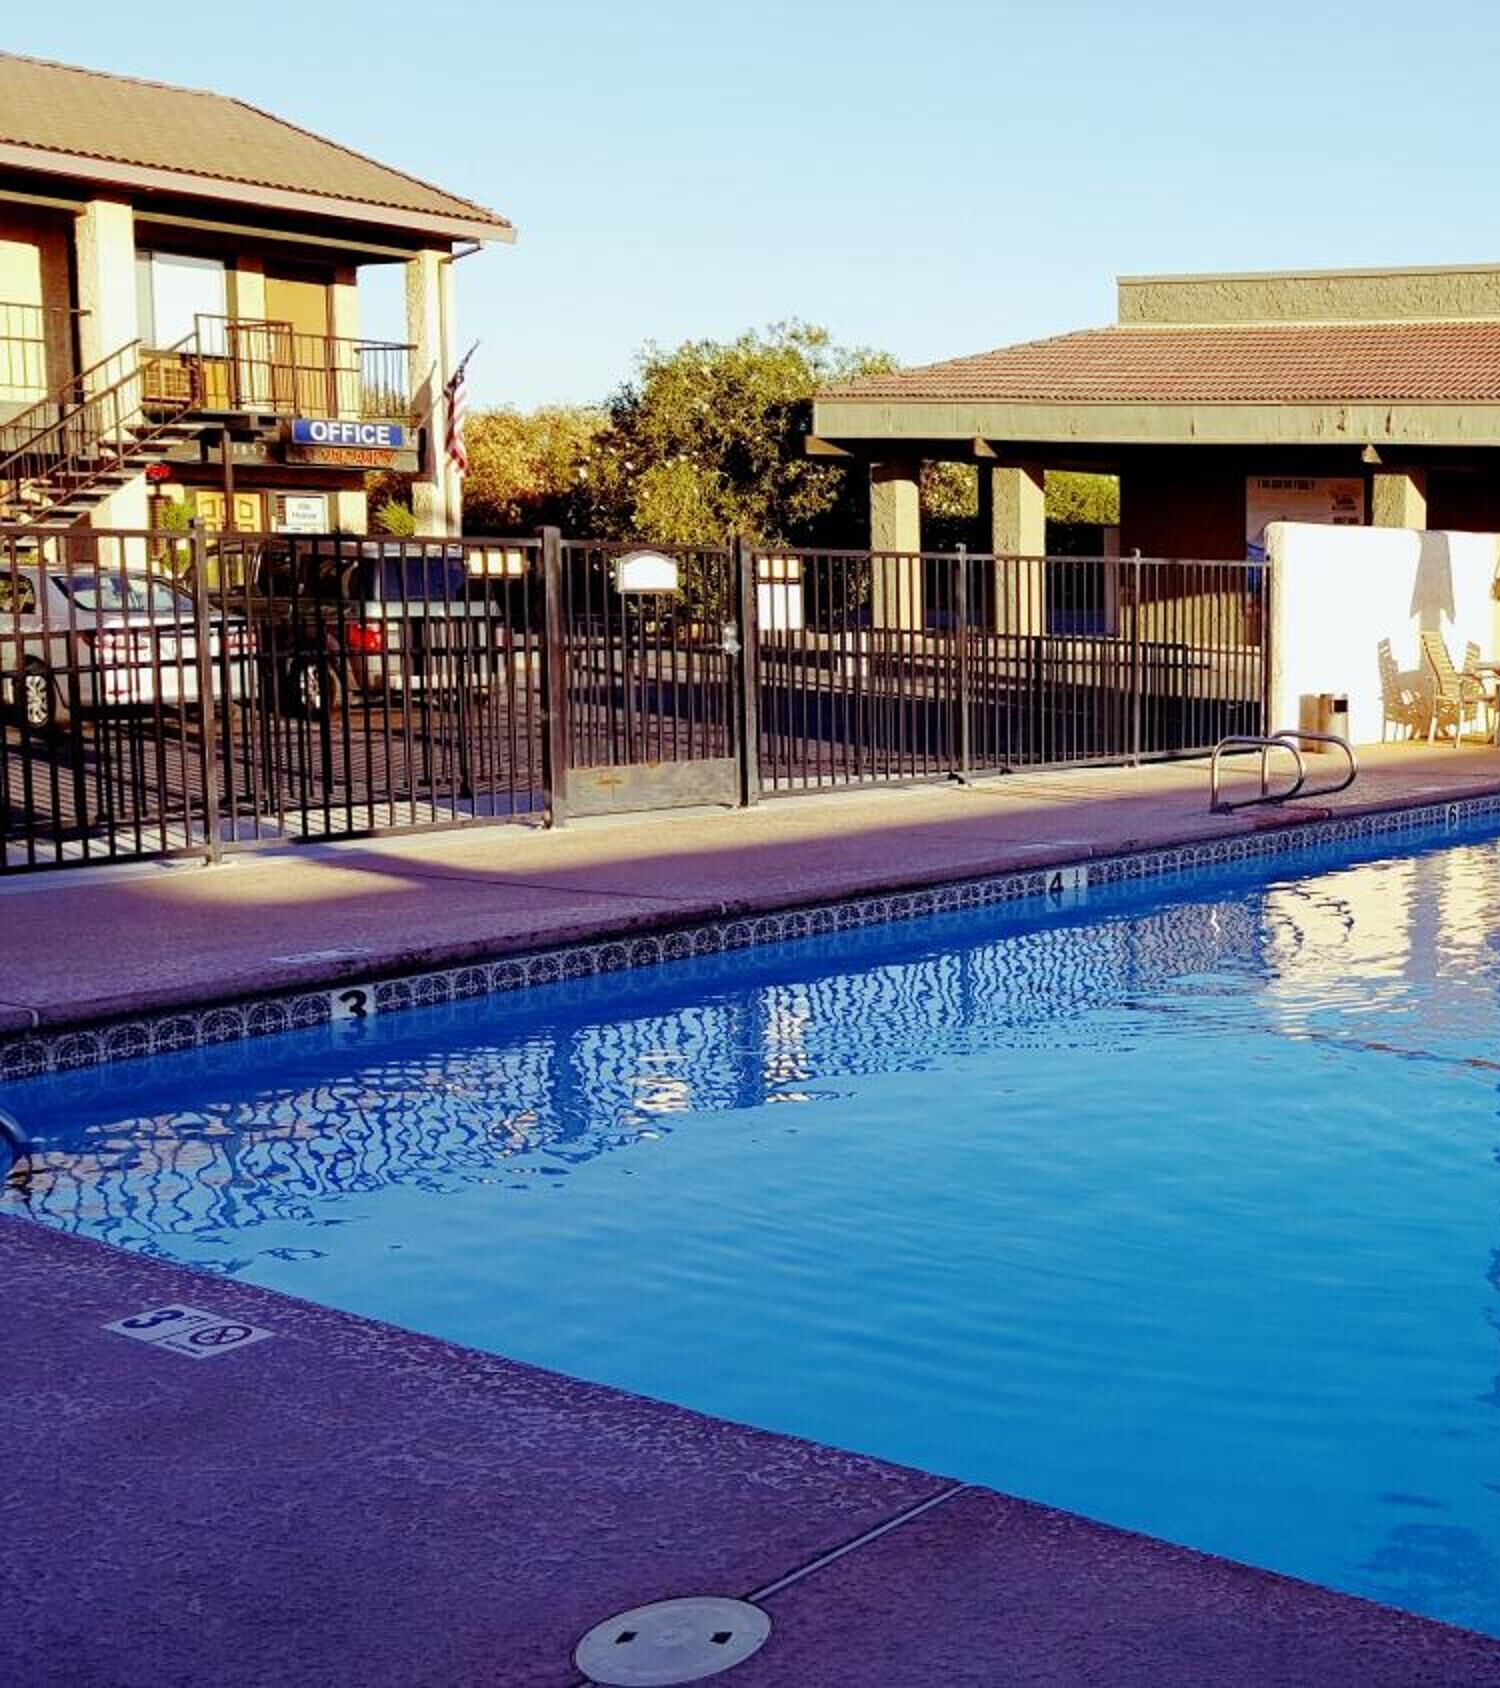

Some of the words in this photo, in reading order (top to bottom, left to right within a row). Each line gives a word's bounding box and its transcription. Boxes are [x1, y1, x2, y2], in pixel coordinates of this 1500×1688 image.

[310, 421, 391, 445] OFFICE
[1448, 804, 1457, 825] 6
[338, 990, 368, 1019] 3
[121, 1309, 185, 1329] 3
